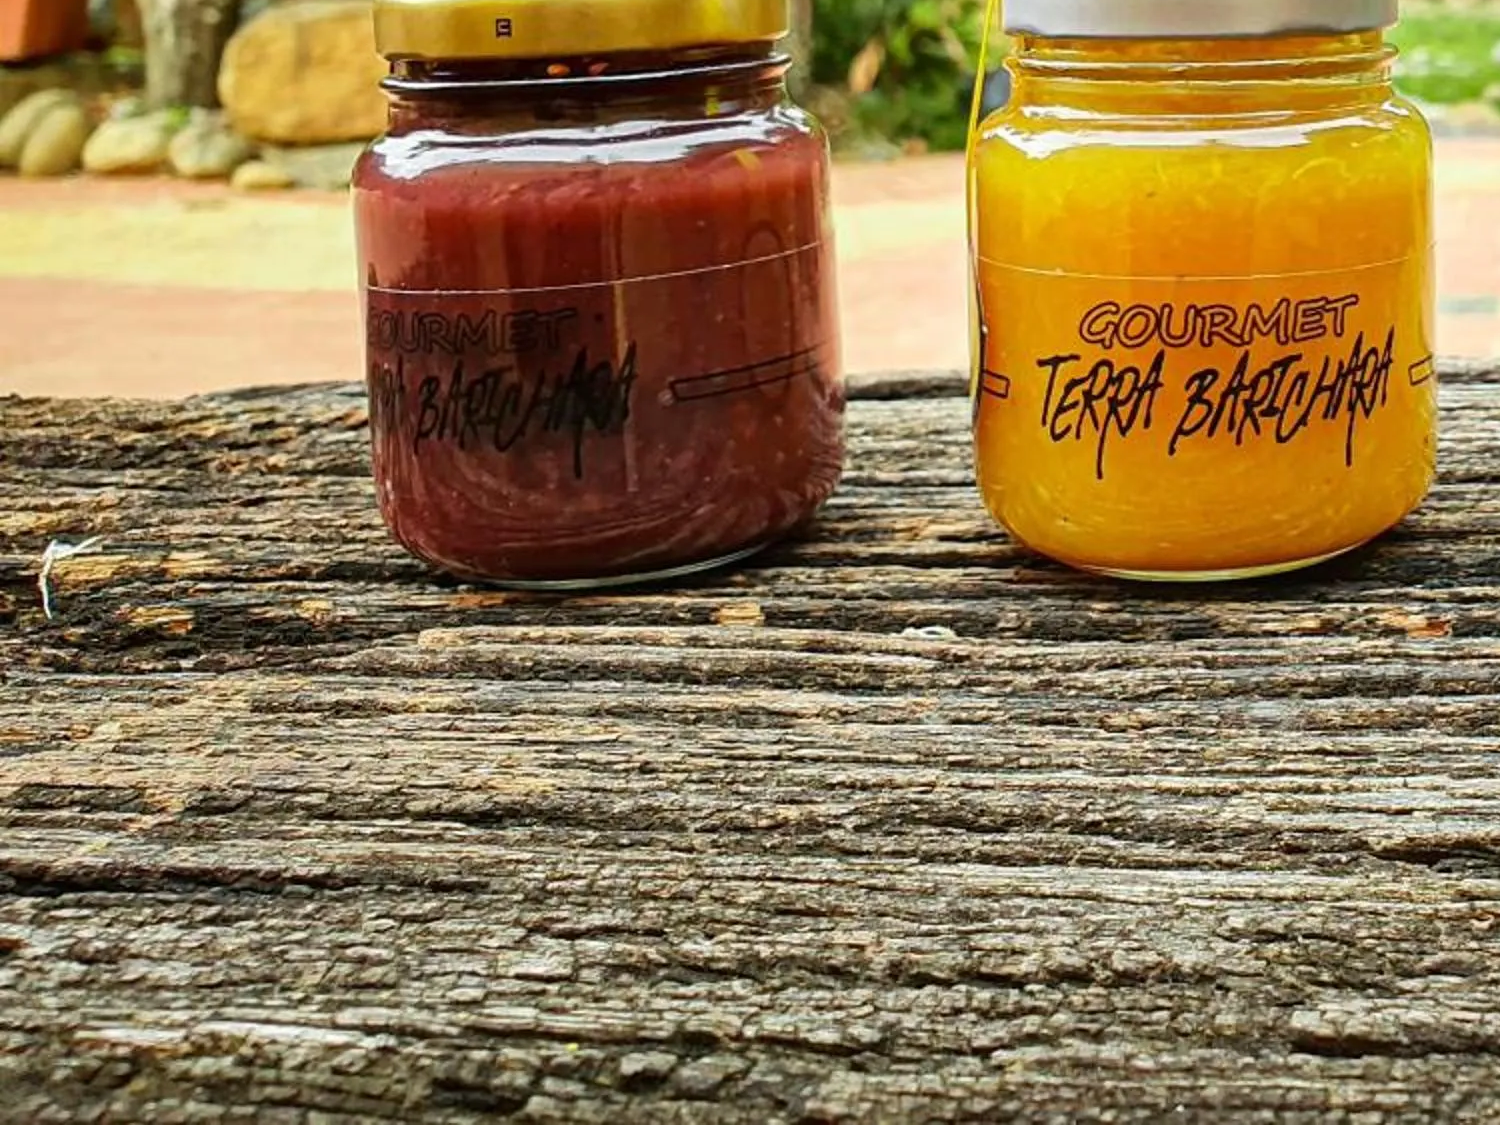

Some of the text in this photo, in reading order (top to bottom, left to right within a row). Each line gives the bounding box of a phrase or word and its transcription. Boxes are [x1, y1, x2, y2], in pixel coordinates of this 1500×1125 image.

[1078, 293, 1359, 349] GOURMET
[1036, 326, 1395, 480] TERRA BARICHARA
